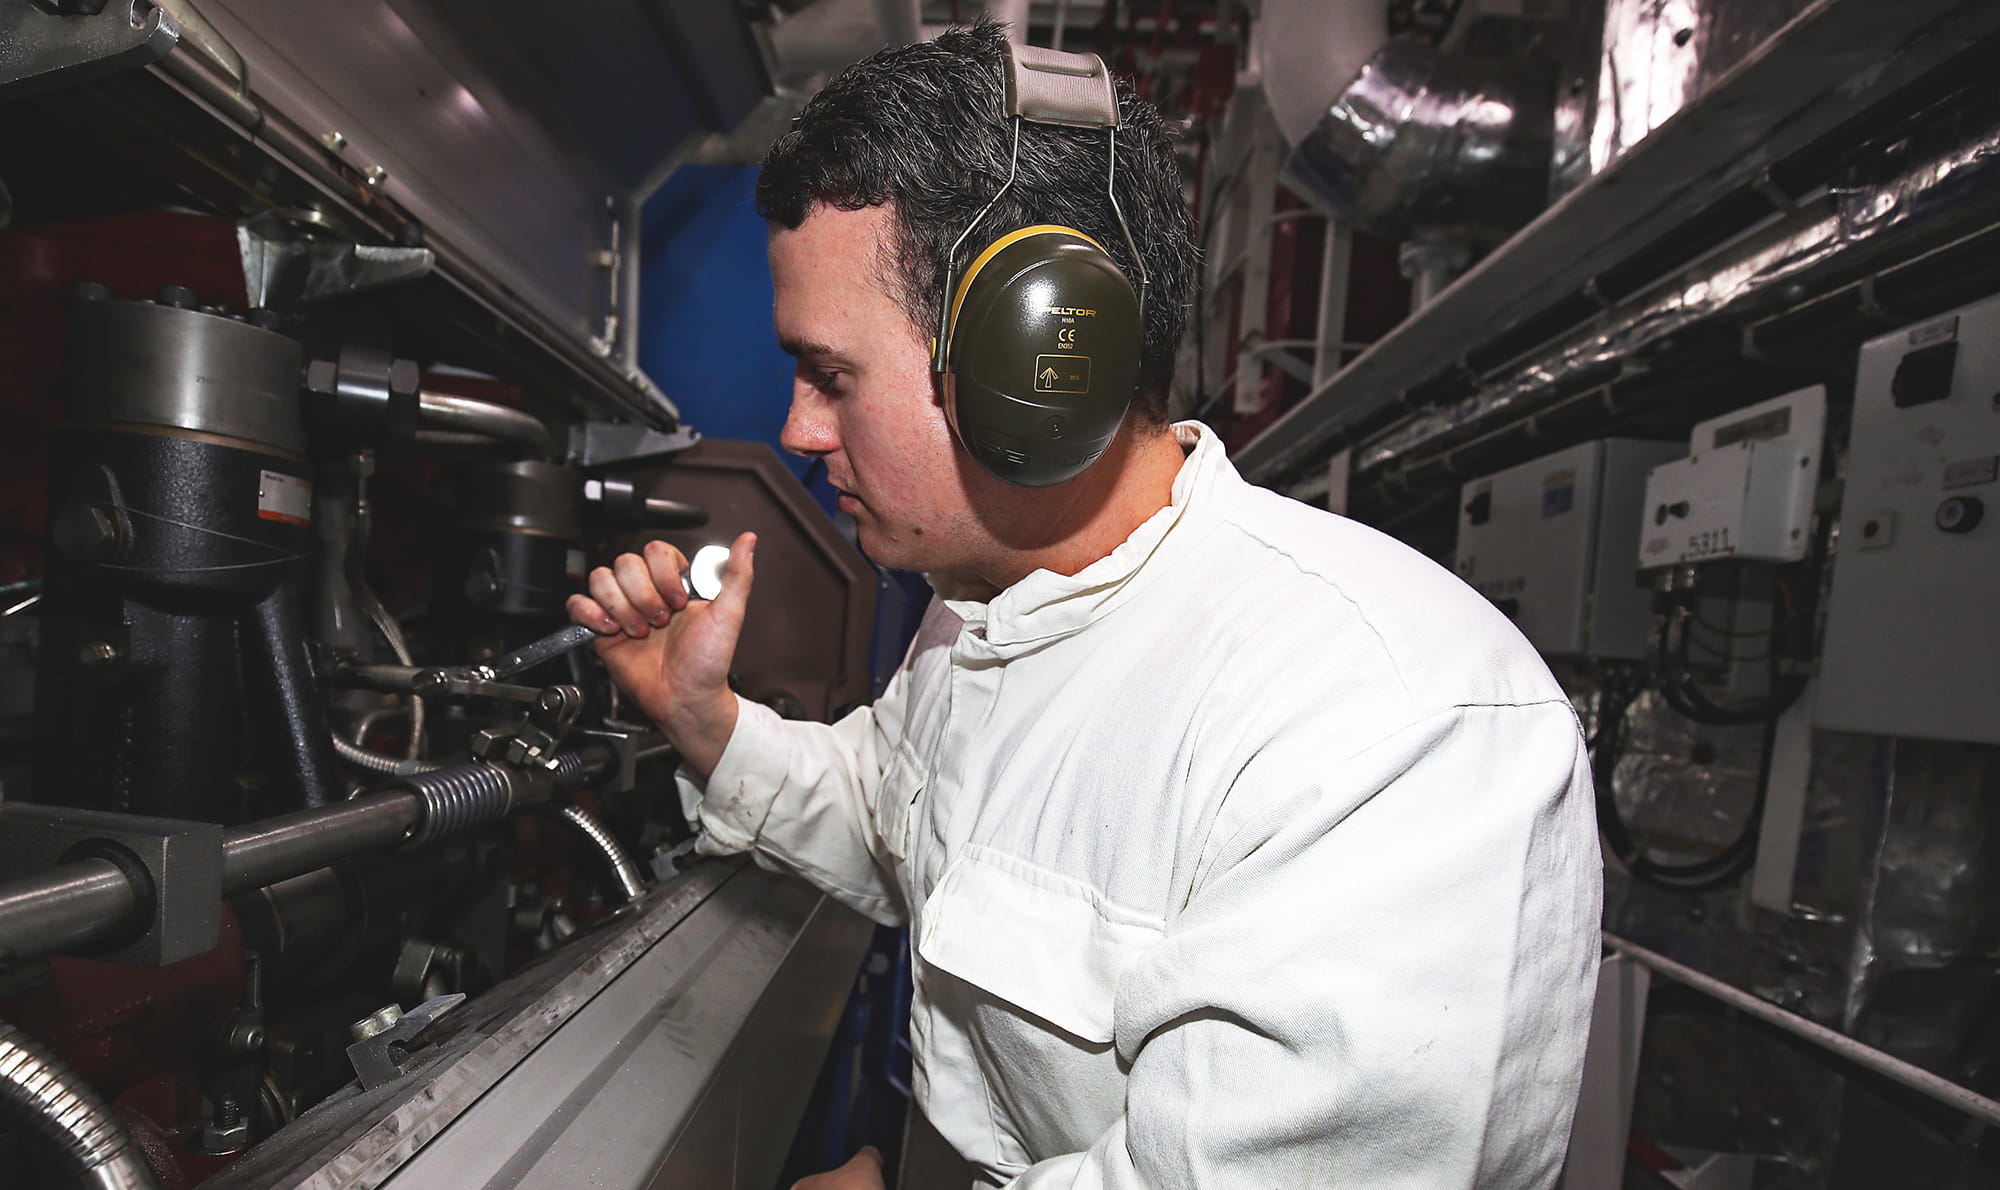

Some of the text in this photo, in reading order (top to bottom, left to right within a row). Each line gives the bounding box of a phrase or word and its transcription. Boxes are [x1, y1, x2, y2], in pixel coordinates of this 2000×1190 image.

[1040, 306, 1097, 317] PELTOR
[1058, 328, 1076, 342] CE
[1687, 526, 1731, 556] 5311
